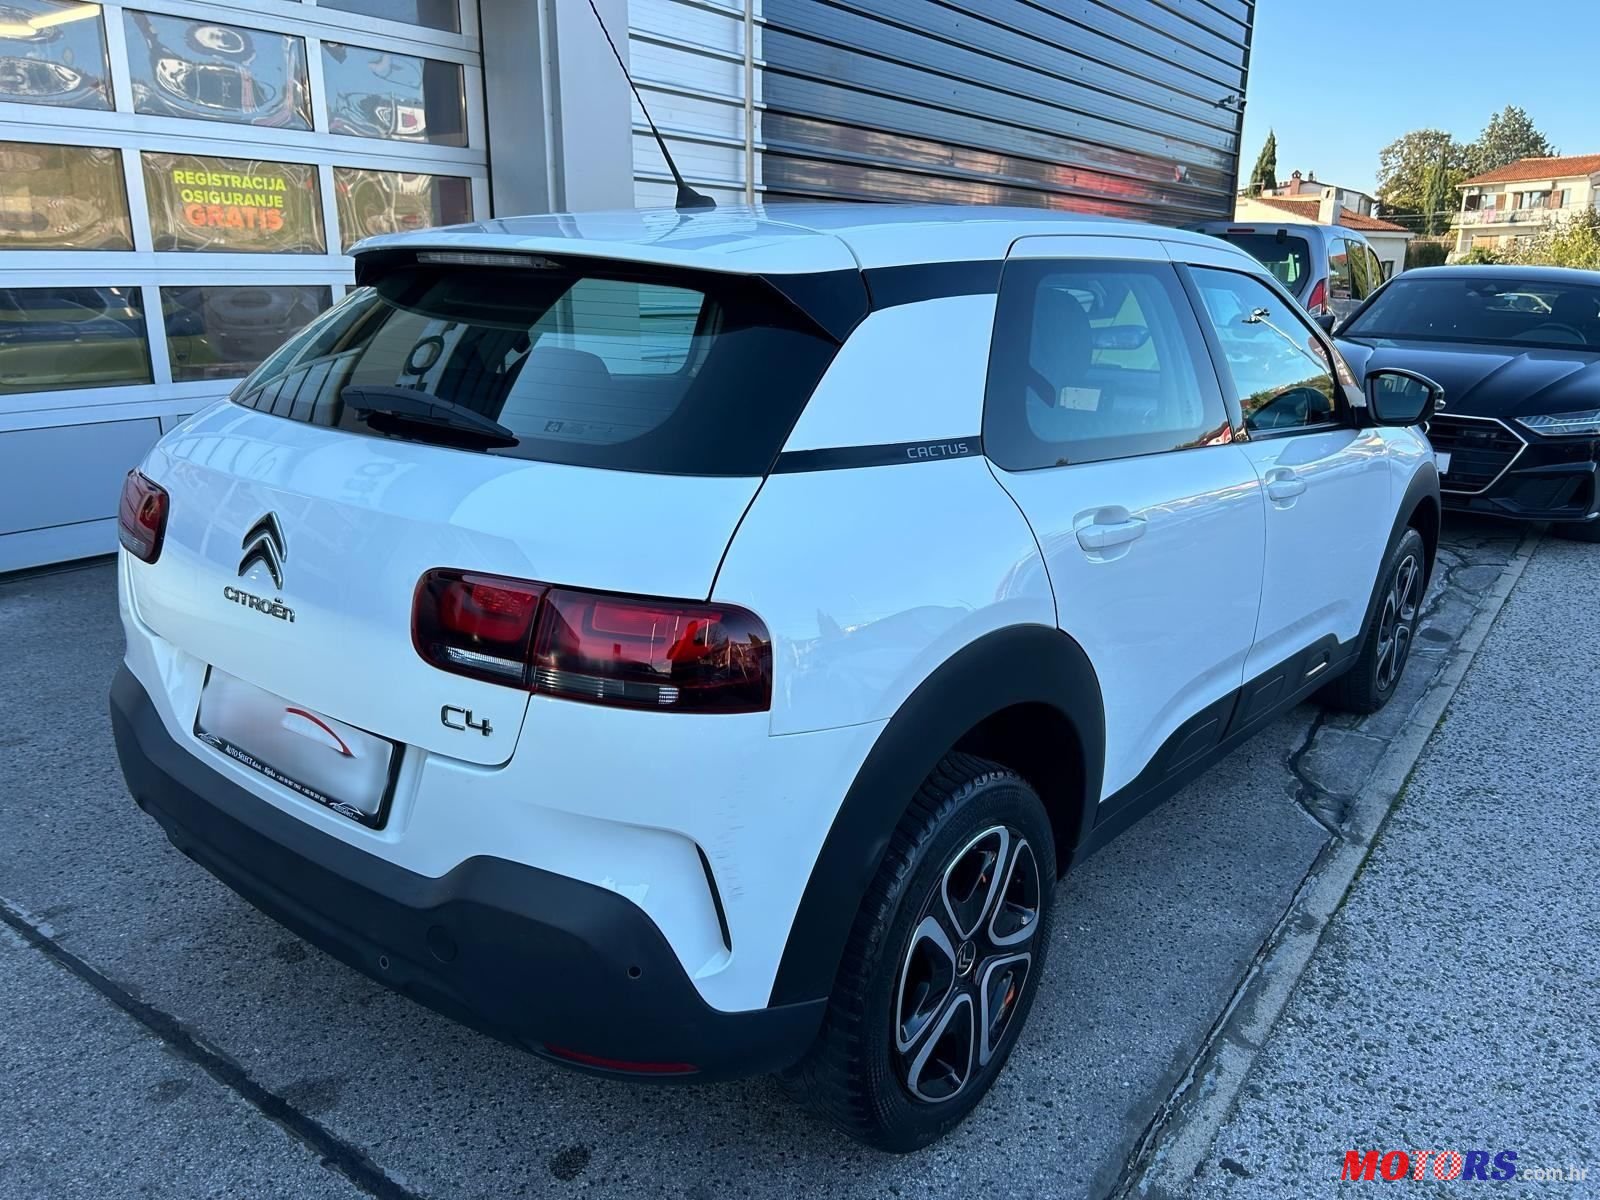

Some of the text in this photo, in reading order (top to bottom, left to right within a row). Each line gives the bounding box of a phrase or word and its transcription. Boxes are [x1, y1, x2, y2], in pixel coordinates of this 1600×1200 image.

[173, 170, 286, 191] REGISTRACIJA
[181, 189, 283, 208] OSIGURANJE
[185, 203, 284, 231] GRATIS
[906, 443, 968, 459] CACTUS
[441, 705, 493, 736] C4
